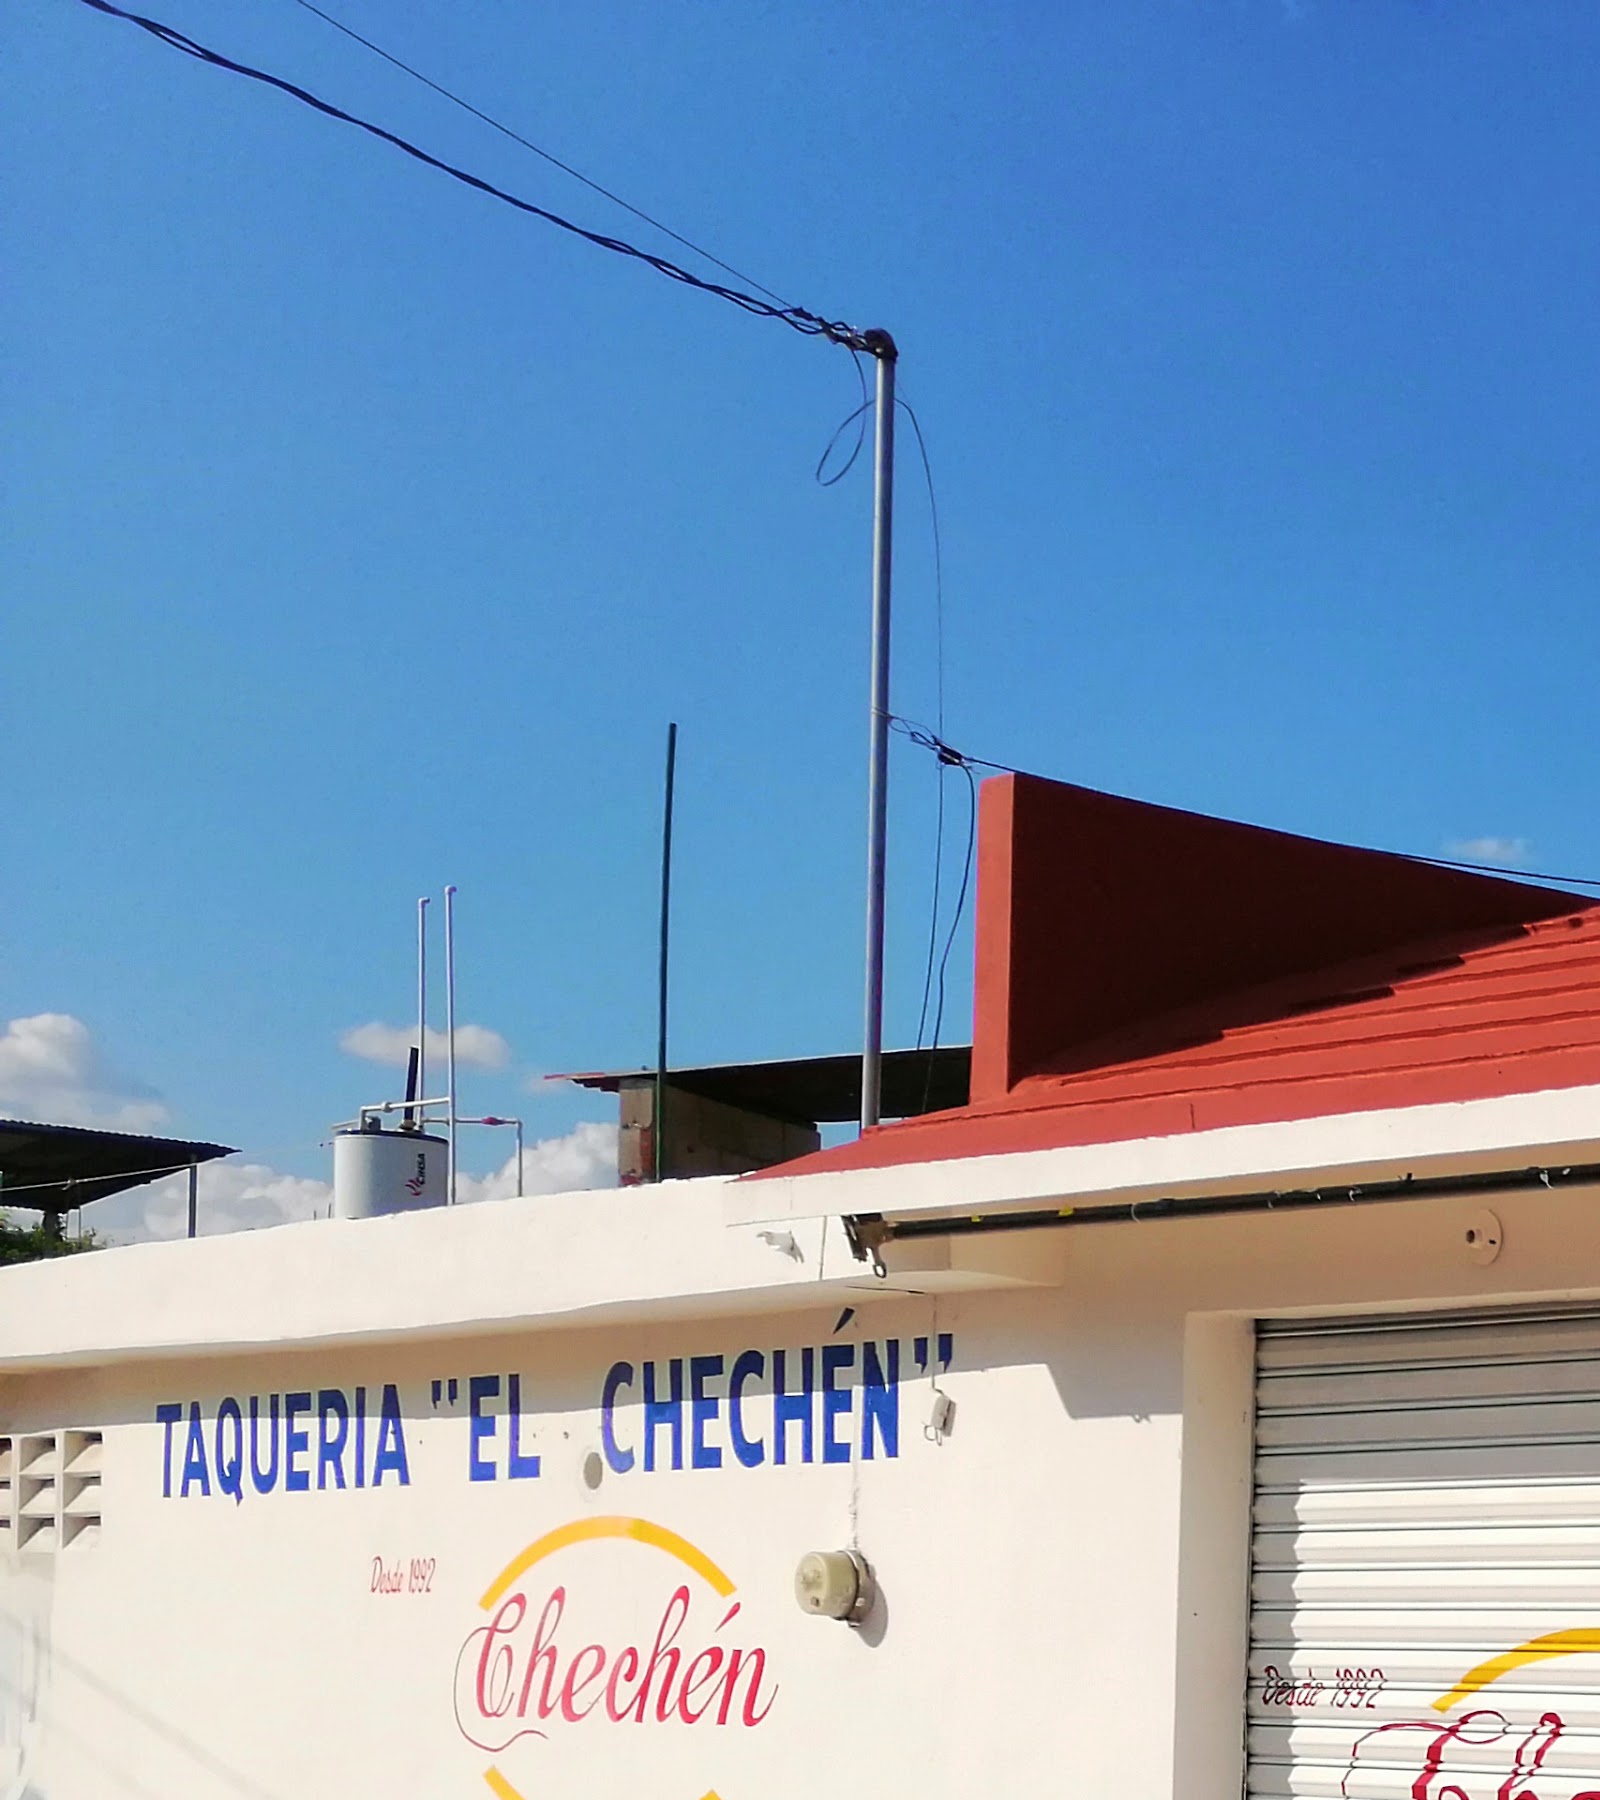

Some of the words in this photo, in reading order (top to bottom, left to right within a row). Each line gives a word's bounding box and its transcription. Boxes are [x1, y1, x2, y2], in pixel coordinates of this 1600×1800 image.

[155, 1383, 411, 1507] TAQUERIA
[408, 1557, 437, 1594] 1992
[453, 1584, 779, 1753] Chechén
[1261, 1664, 1325, 1707] Desde
[1329, 1667, 1389, 1709] 1992
